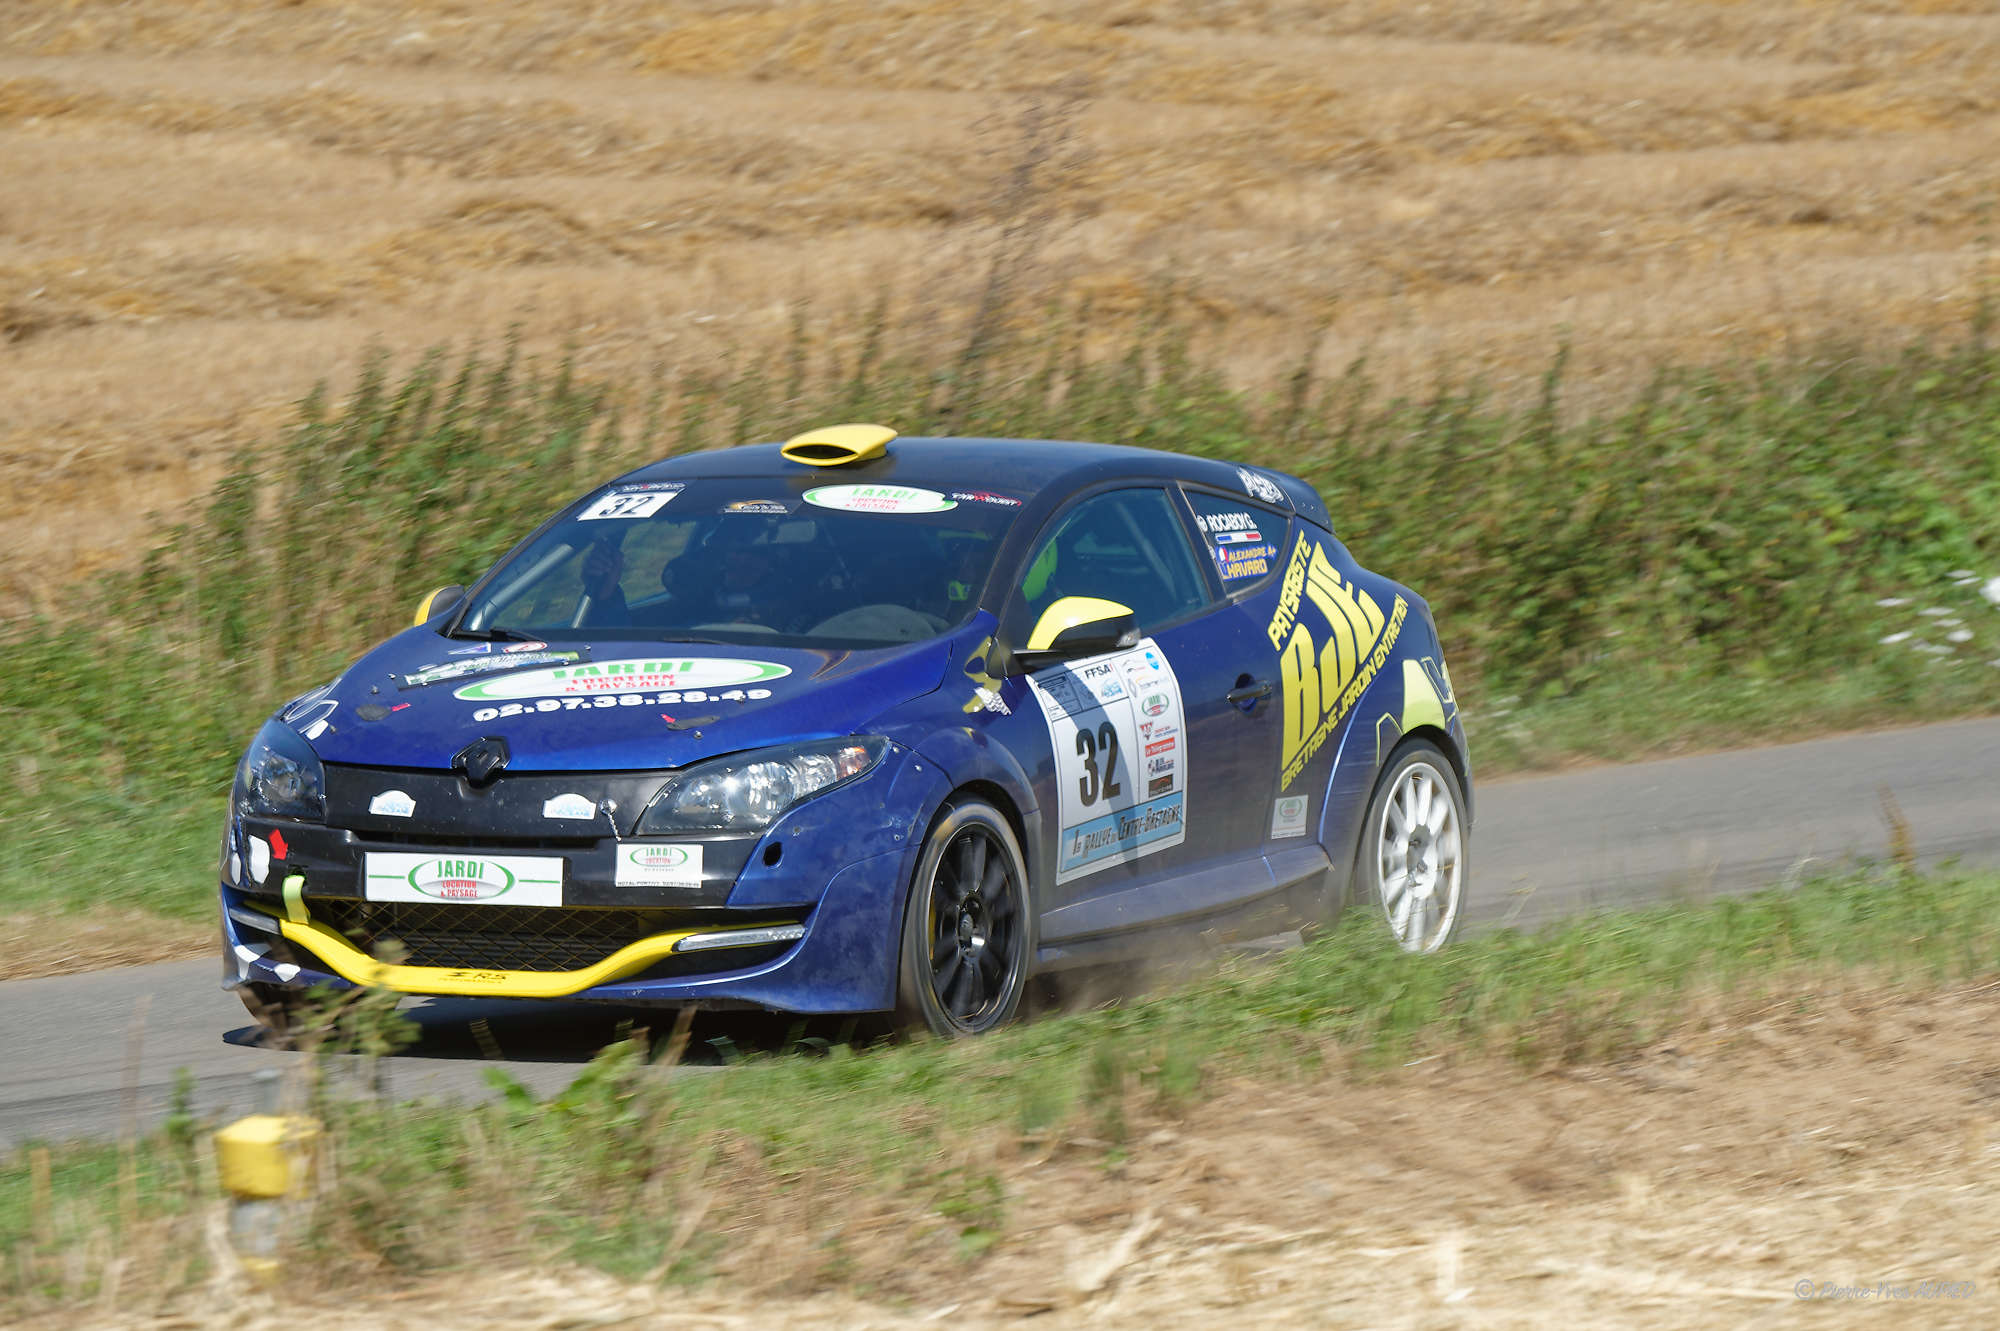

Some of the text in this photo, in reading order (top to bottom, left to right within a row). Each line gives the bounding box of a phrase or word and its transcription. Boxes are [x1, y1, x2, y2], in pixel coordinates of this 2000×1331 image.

[599, 496, 654, 516] 32
[1228, 547, 1267, 562] ALEXANDRE
[1267, 529, 1312, 651] PAYSAGISTE
[553, 661, 695, 679] JARDI
[1084, 664, 1112, 679] FFSA
[572, 674, 675, 685] LOCATION
[586, 681, 676, 690] PAYSAGE
[1281, 706, 1338, 792] BRETAGNE
[1338, 656, 1377, 719] JARDIN
[1373, 592, 1409, 677] ENTRETIEN
[473, 688, 772, 722] 02.97.38.28.49
[1075, 721, 1121, 808] 32
[646, 847, 672, 857] JARDI
[437, 860, 485, 879] JARDI
[442, 880, 477, 889] LOCATION
[447, 889, 479, 898] PAYSAGE
